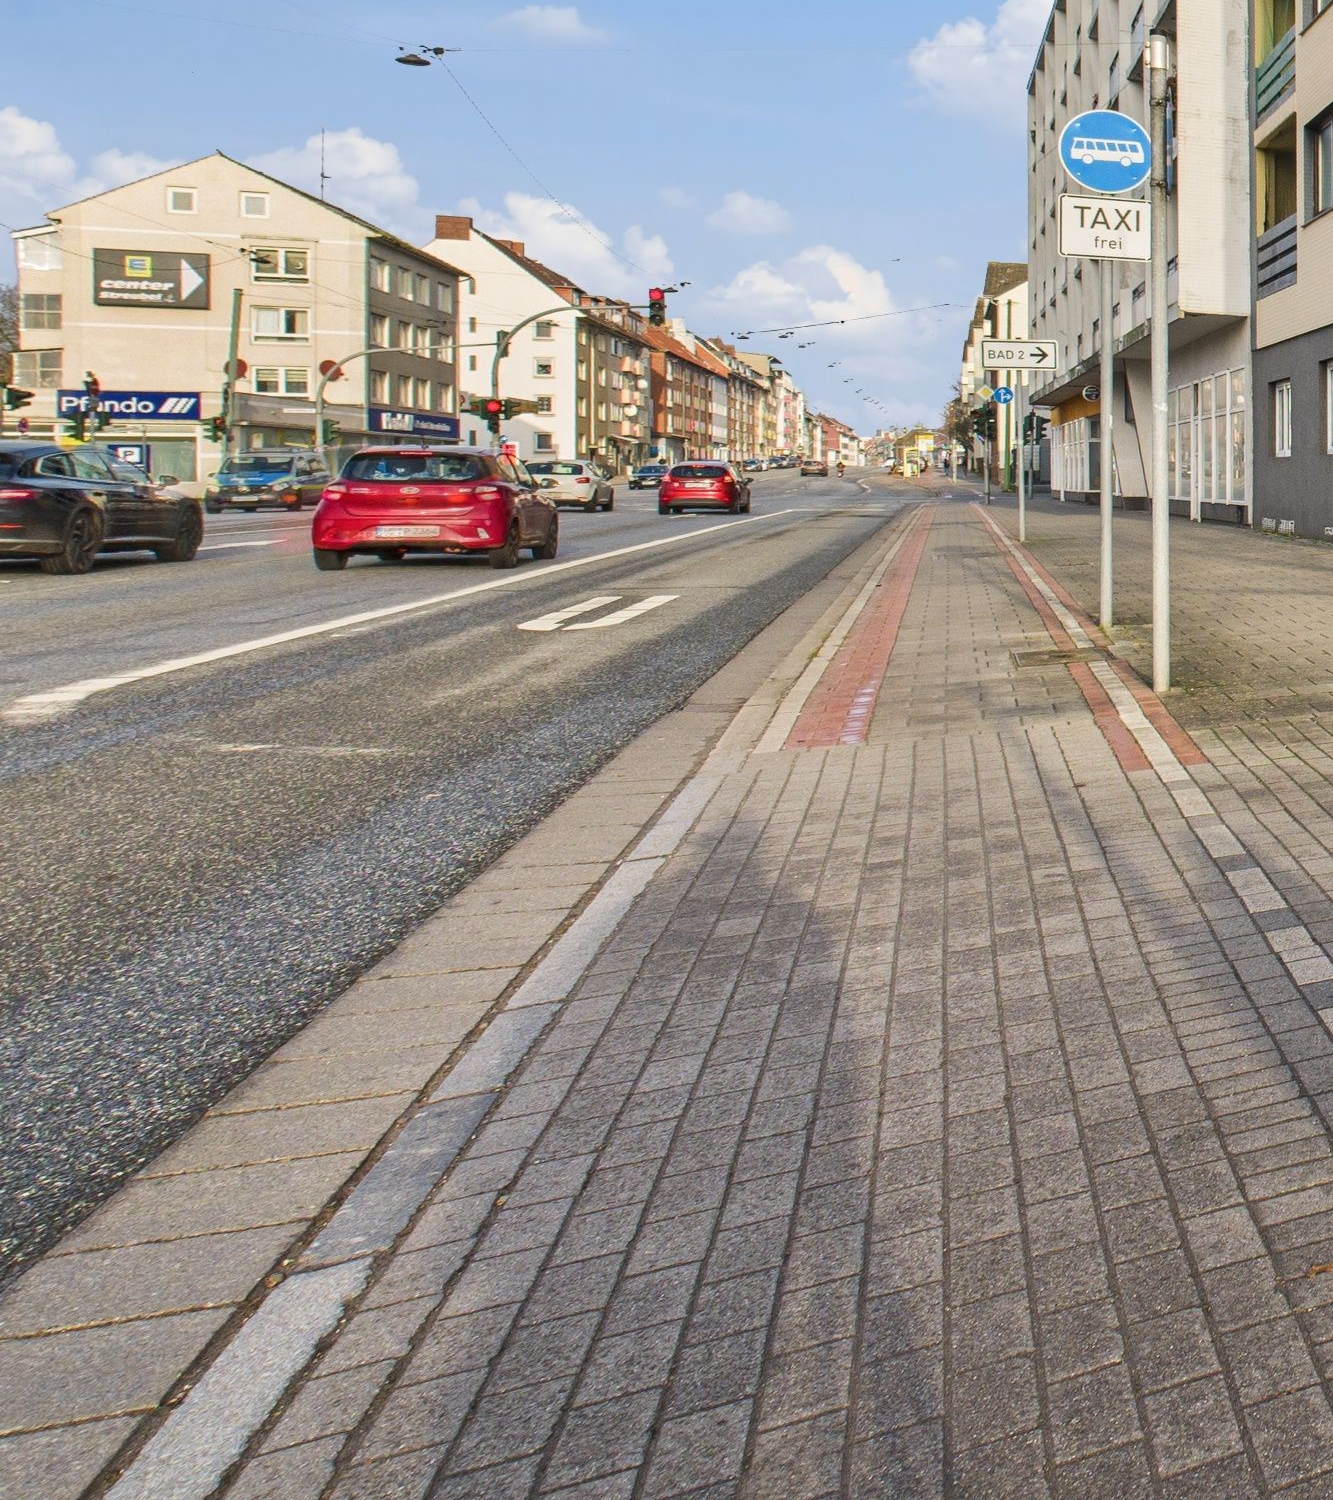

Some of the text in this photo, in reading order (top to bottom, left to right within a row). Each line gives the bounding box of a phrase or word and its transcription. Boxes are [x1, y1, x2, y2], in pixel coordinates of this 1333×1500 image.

[1073, 205, 1141, 232] TAXI
[1094, 235, 1122, 250] frei
[100, 279, 175, 291] center
[987, 349, 1025, 360] BAD 2
[60, 396, 154, 414] Pfndo
